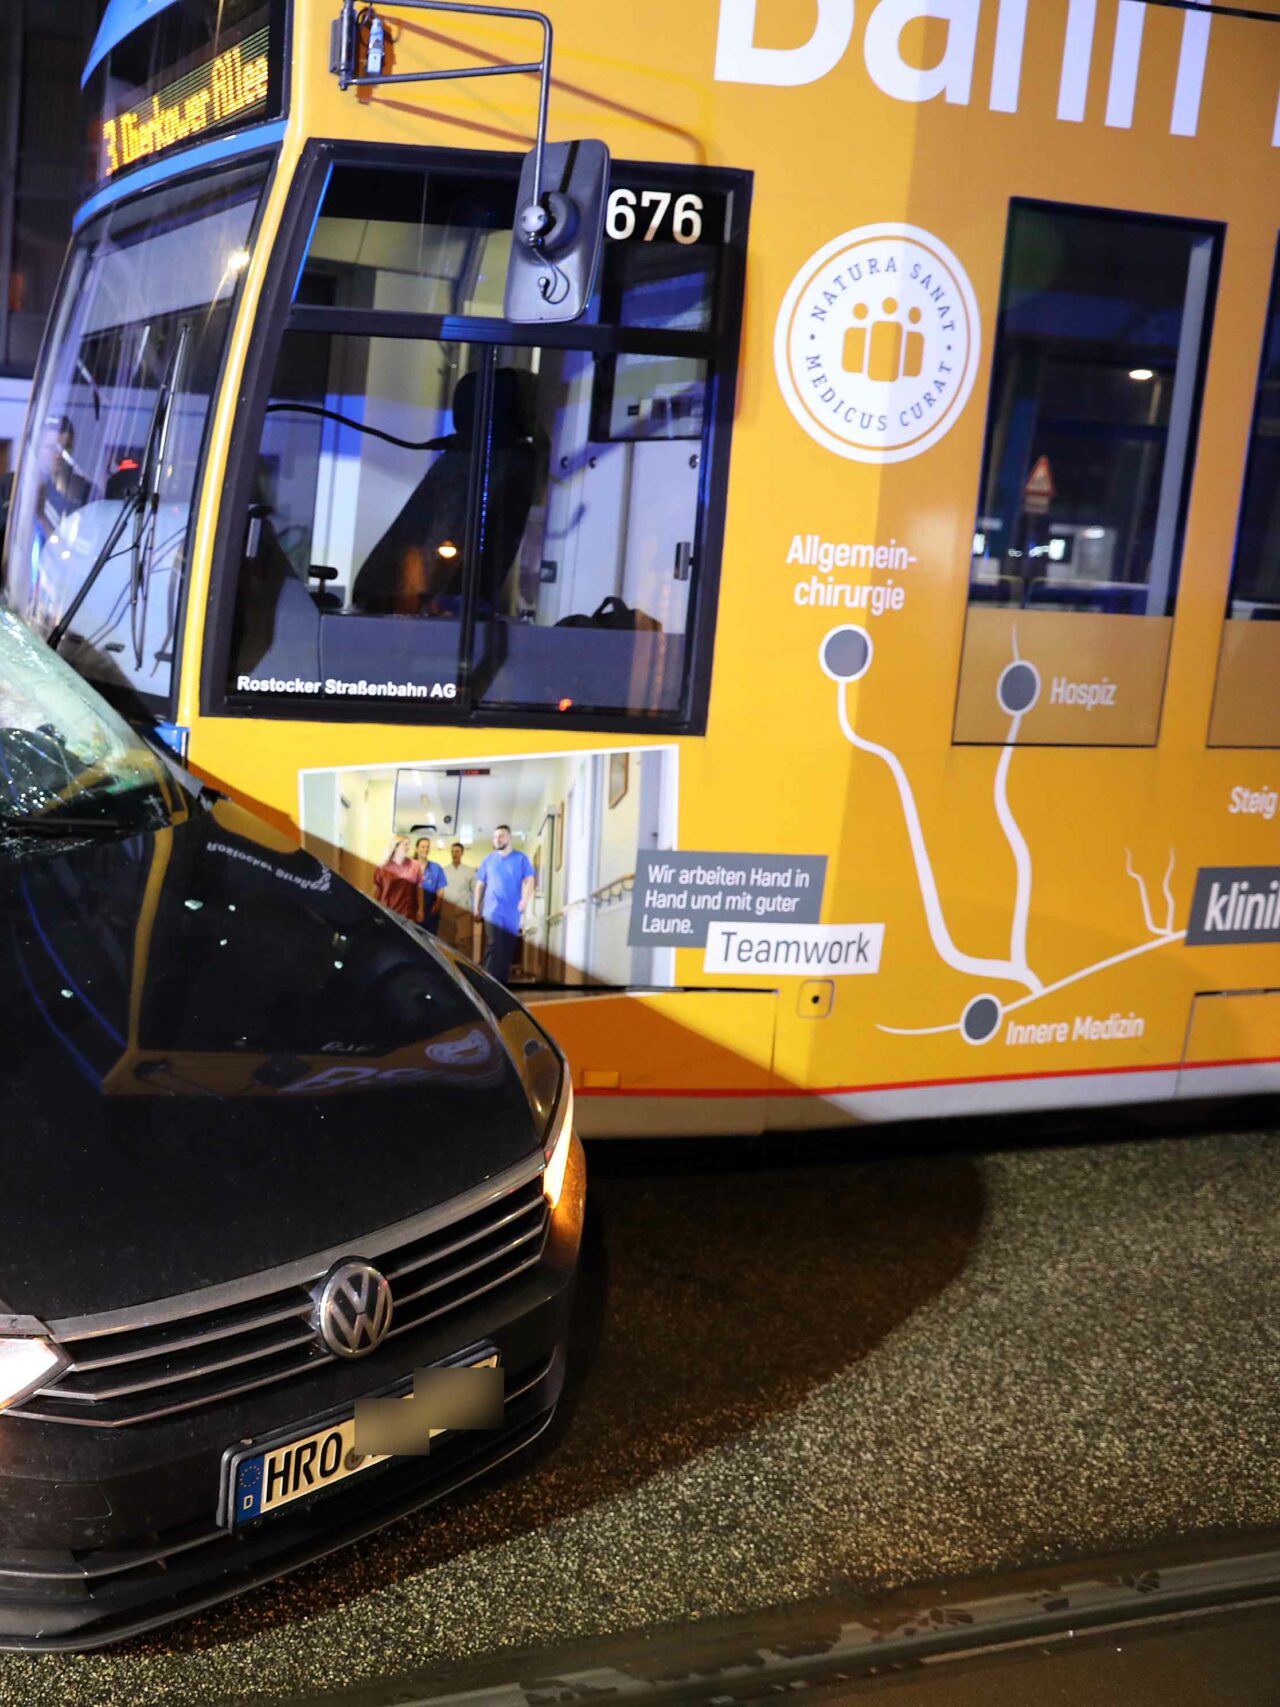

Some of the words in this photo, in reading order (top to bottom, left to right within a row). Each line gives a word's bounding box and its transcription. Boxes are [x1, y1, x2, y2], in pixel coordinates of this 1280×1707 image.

[606, 188, 704, 245] 676
[811, 256, 898, 322] NATURA
[909, 262, 955, 331] SANAT
[805, 354, 888, 431] MEDICUS
[899, 361, 952, 427] CURAT
[786, 534, 918, 573] Allgemein-
[794, 575, 905, 616] chirurgie
[237, 676, 321, 693] Rostocker
[324, 679, 428, 698] Straßenbahn
[430, 683, 456, 699] AG
[1050, 676, 1117, 711] Hospiz
[1228, 785, 1278, 819] Steig
[648, 865, 675, 884] Wir
[679, 866, 746, 886] arbeiten
[750, 868, 793, 888] Hand
[795, 869, 810, 888] in
[645, 890, 687, 909] Hand
[690, 891, 722, 911] und
[725, 892, 753, 911] mit
[756, 895, 800, 916] guter
[642, 914, 694, 935] Laune.
[720, 932, 870, 965] Teamwork
[1005, 1020, 1069, 1046] Innere
[1071, 1011, 1145, 1041] Medizin
[243, 1494, 254, 1510] D
[265, 1431, 343, 1503] HRO
